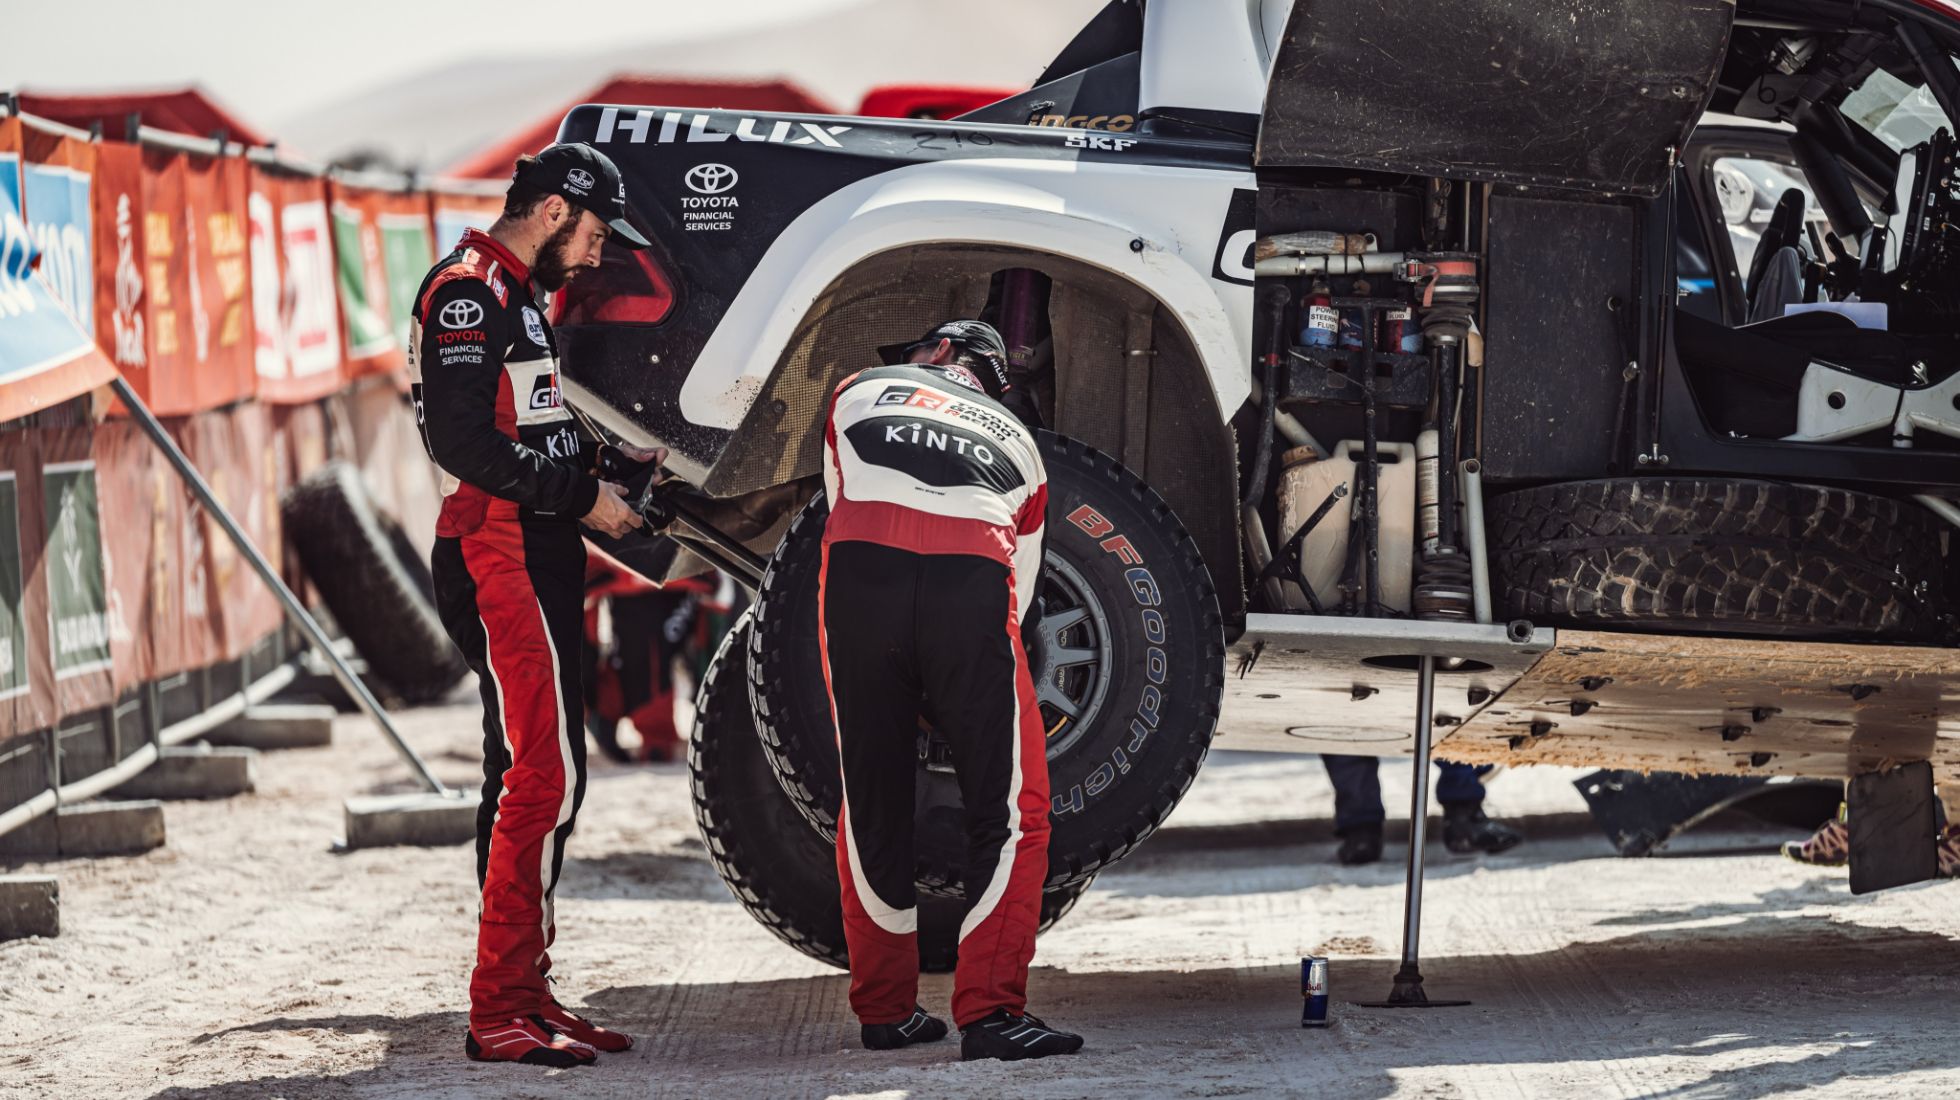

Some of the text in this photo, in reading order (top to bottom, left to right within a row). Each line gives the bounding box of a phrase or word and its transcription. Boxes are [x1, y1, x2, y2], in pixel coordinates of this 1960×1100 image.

[594, 107, 853, 148] HILUX
[1064, 135, 1138, 152] SKF
[680, 196, 739, 209] TOYOTA
[683, 211, 735, 221] FINANCIAL
[685, 221, 732, 231] SERVICES
[436, 329, 487, 345] TOYOTA
[439, 345, 486, 356] FINANCIAL
[442, 354, 483, 366] SERVICES
[990, 358, 1008, 385] HILUX
[877, 391, 942, 409] GR
[1051, 504, 1168, 814] BFGoodrich
